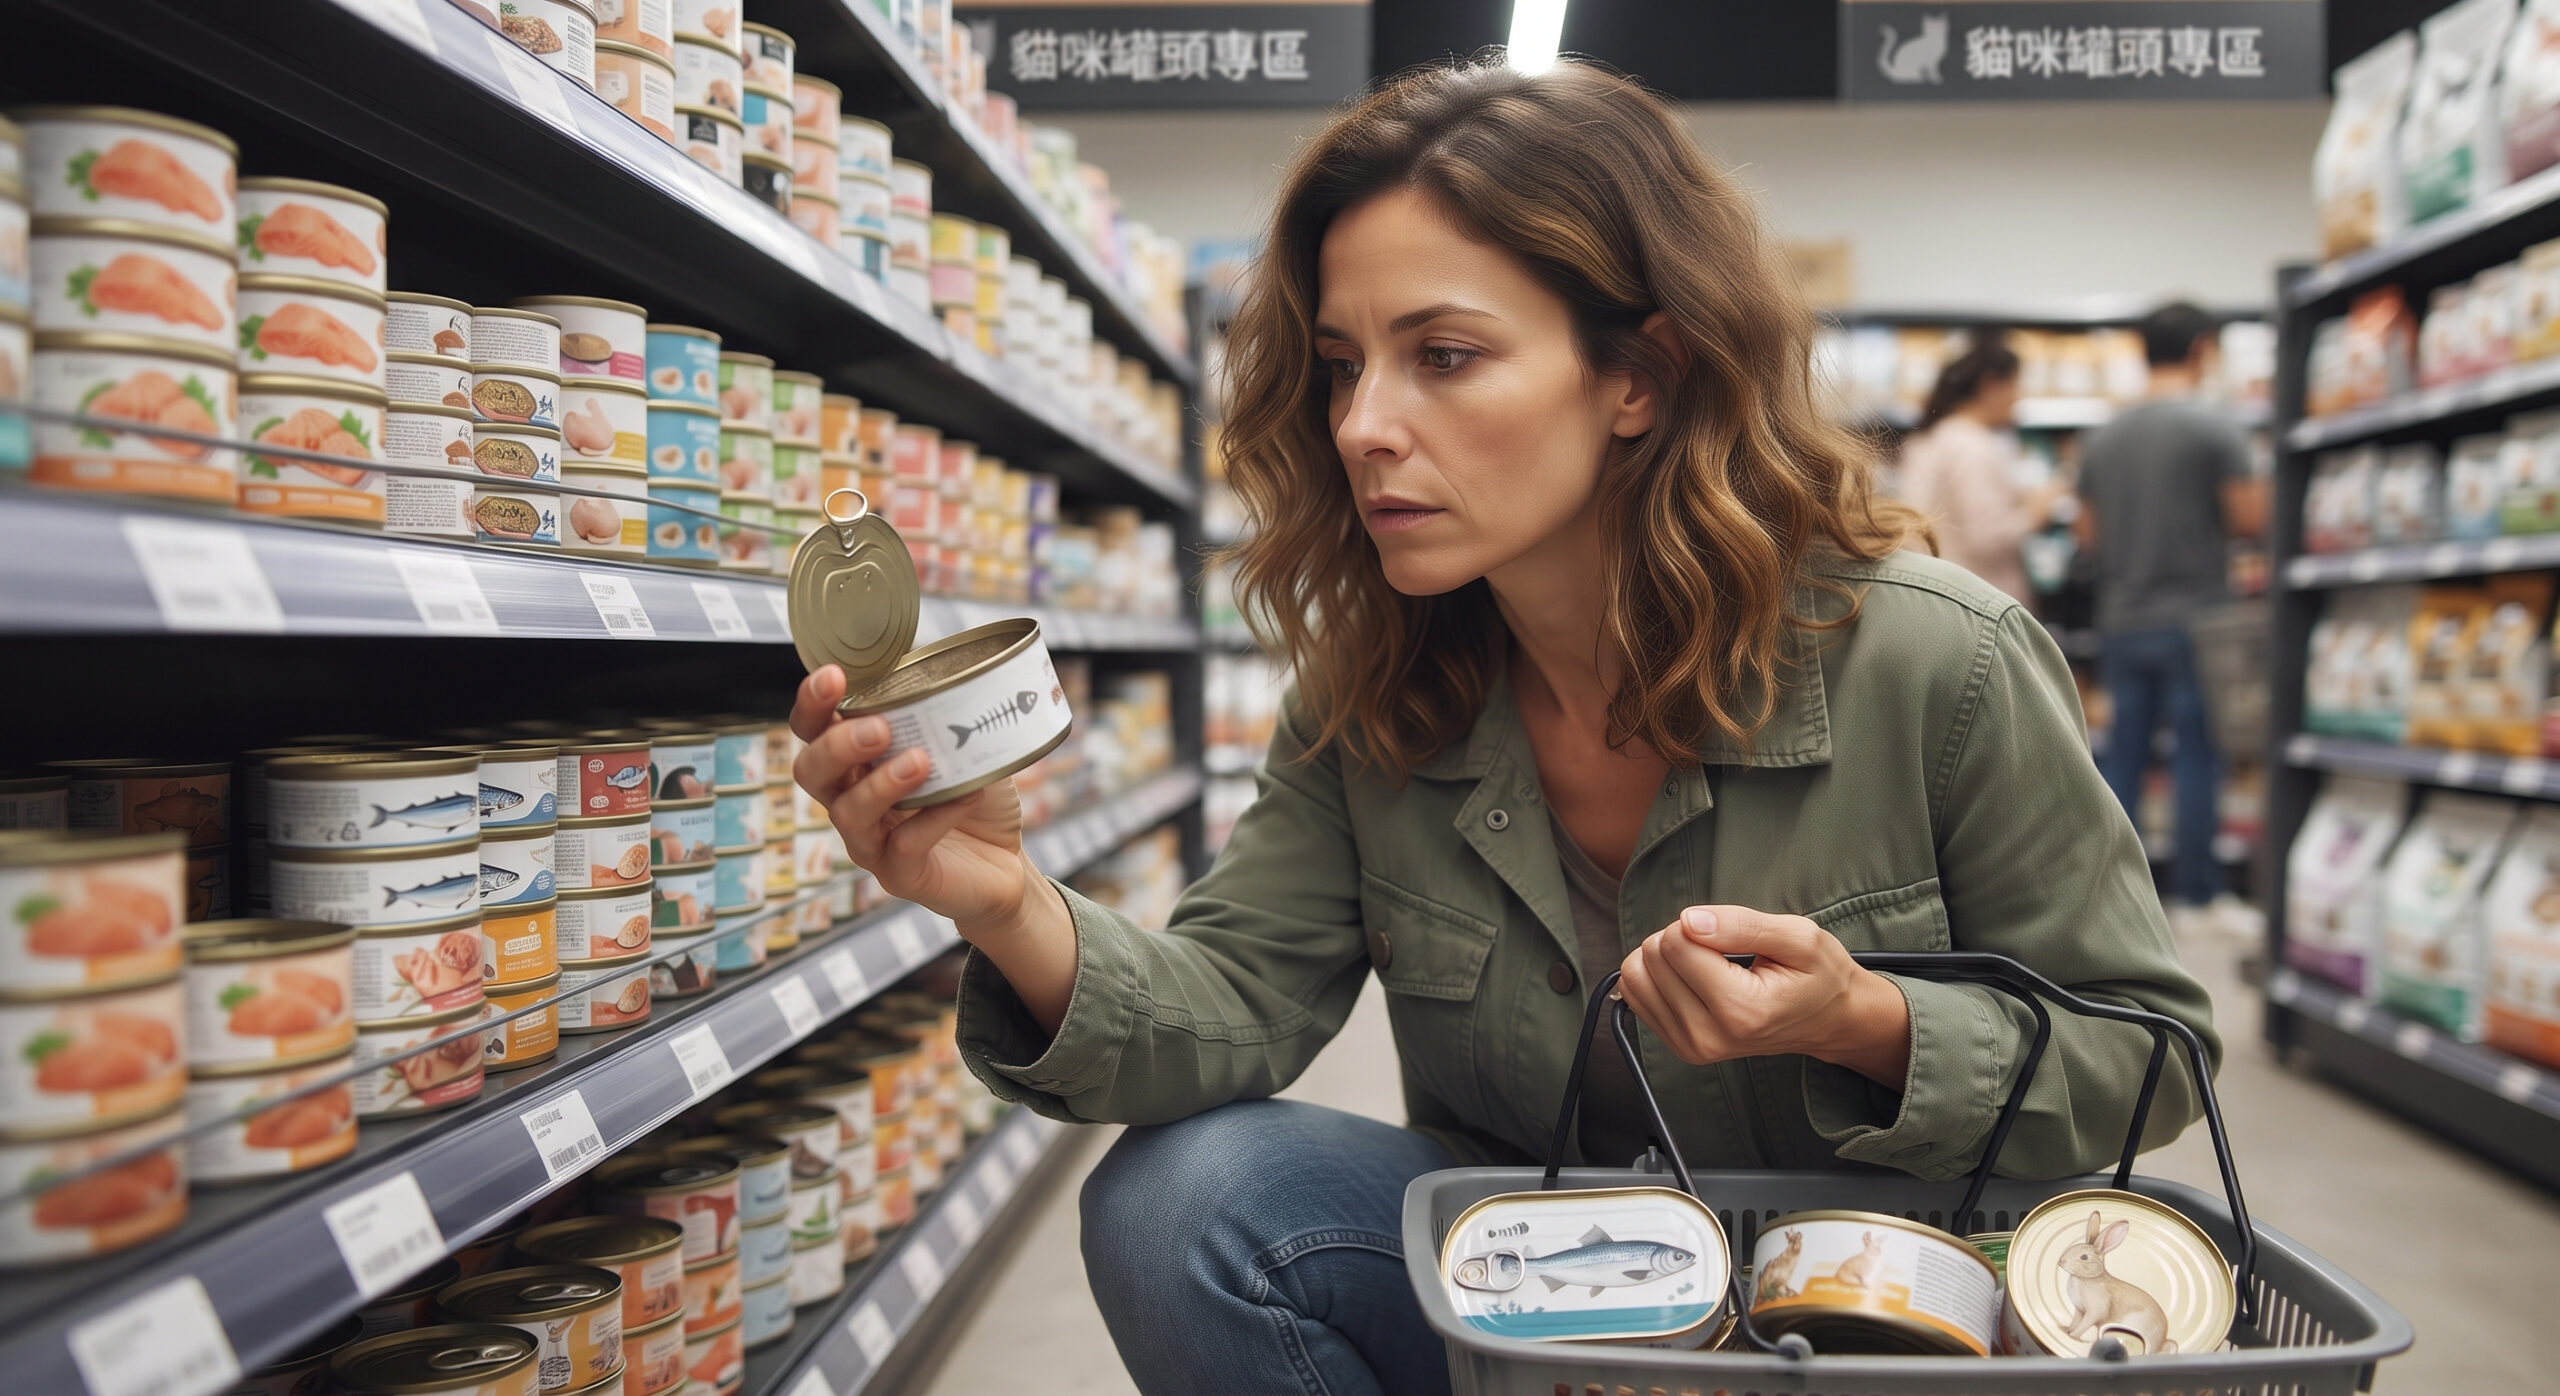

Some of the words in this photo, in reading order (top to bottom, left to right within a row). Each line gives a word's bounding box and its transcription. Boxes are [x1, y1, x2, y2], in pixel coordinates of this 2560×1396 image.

[1009, 28, 1309, 82] 貓咪罐頭專區
[1965, 26, 2265, 79] 貓咪罐頭專區
